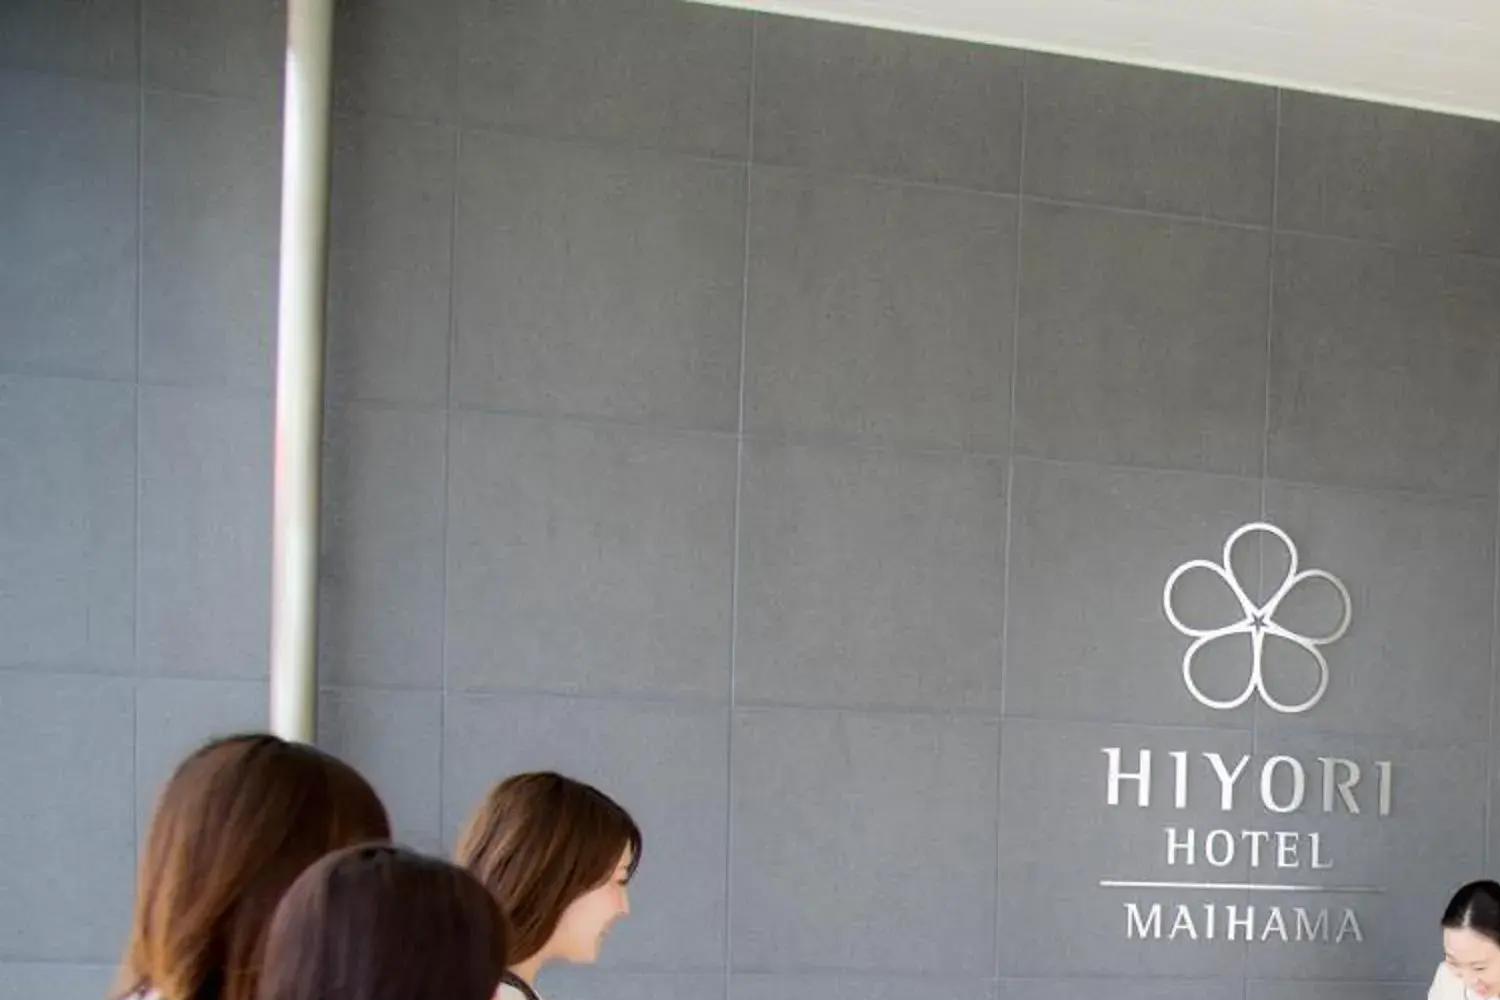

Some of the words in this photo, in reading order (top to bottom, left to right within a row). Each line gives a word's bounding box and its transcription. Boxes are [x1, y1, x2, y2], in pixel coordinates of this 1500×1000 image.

[1102, 747, 1392, 815] HIYORI
[1164, 828, 1334, 869] HOTEL
[1124, 903, 1364, 943] MAIHAMA
